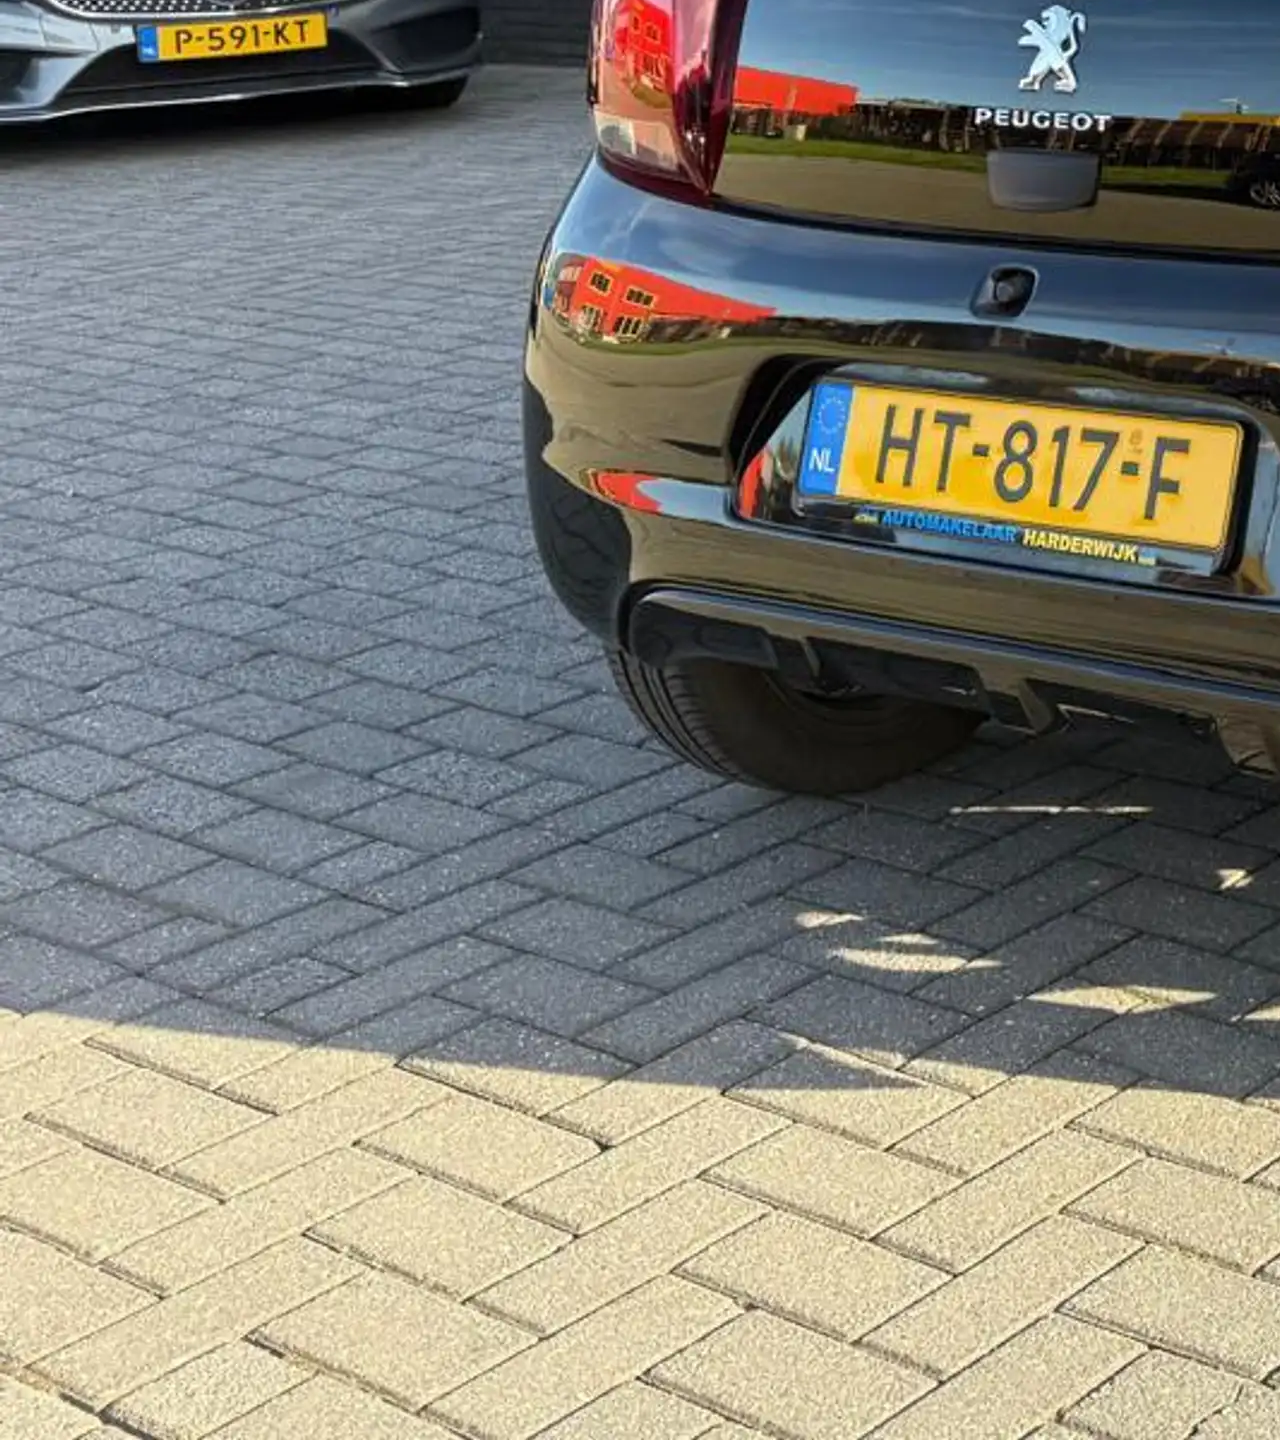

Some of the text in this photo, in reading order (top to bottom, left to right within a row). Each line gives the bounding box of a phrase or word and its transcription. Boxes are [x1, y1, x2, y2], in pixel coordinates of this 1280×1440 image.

[174, 20, 310, 54] P-591-KT
[974, 107, 1112, 132] PEUGEOT
[809, 446, 835, 473] NL
[875, 403, 1191, 521] HT-817-F
[882, 509, 1017, 543] AUTOMAKELAAR
[1023, 527, 1138, 563] HARDERWIJK
